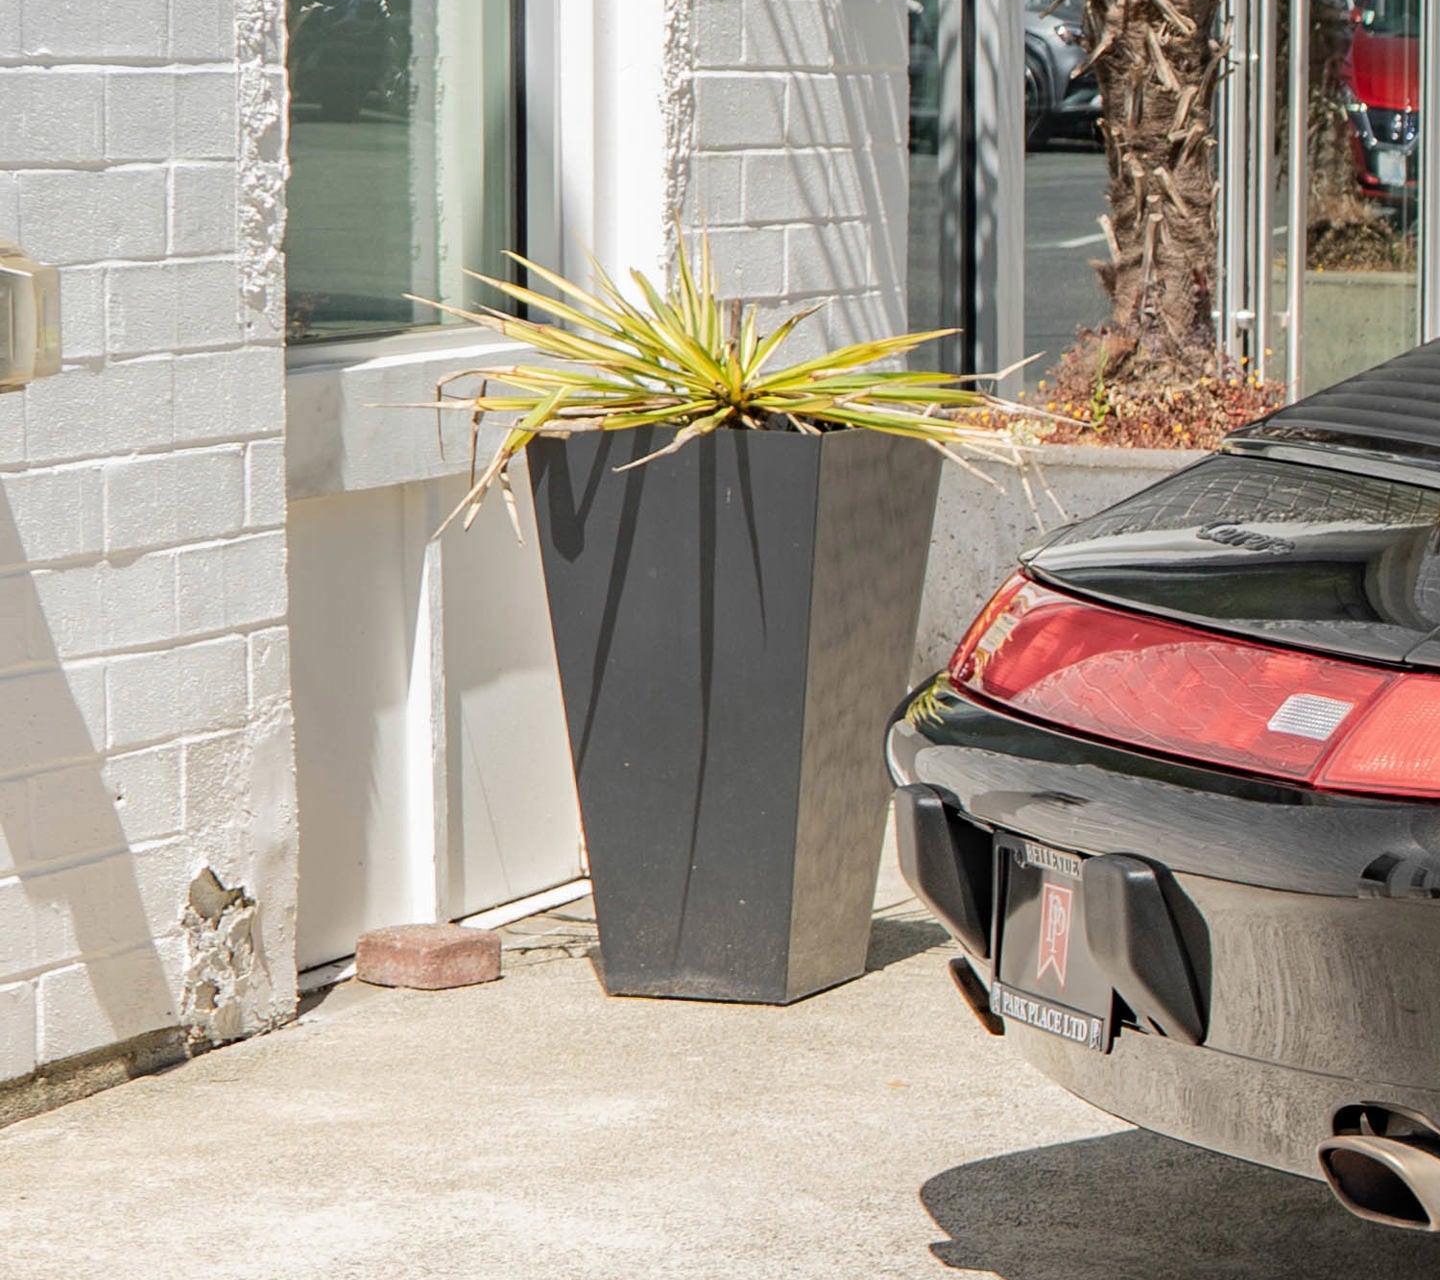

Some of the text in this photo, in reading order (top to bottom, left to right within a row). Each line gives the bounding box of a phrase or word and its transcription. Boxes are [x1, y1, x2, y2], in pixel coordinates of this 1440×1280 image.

[1002, 990, 1088, 1042] PARK PLACE LTD
